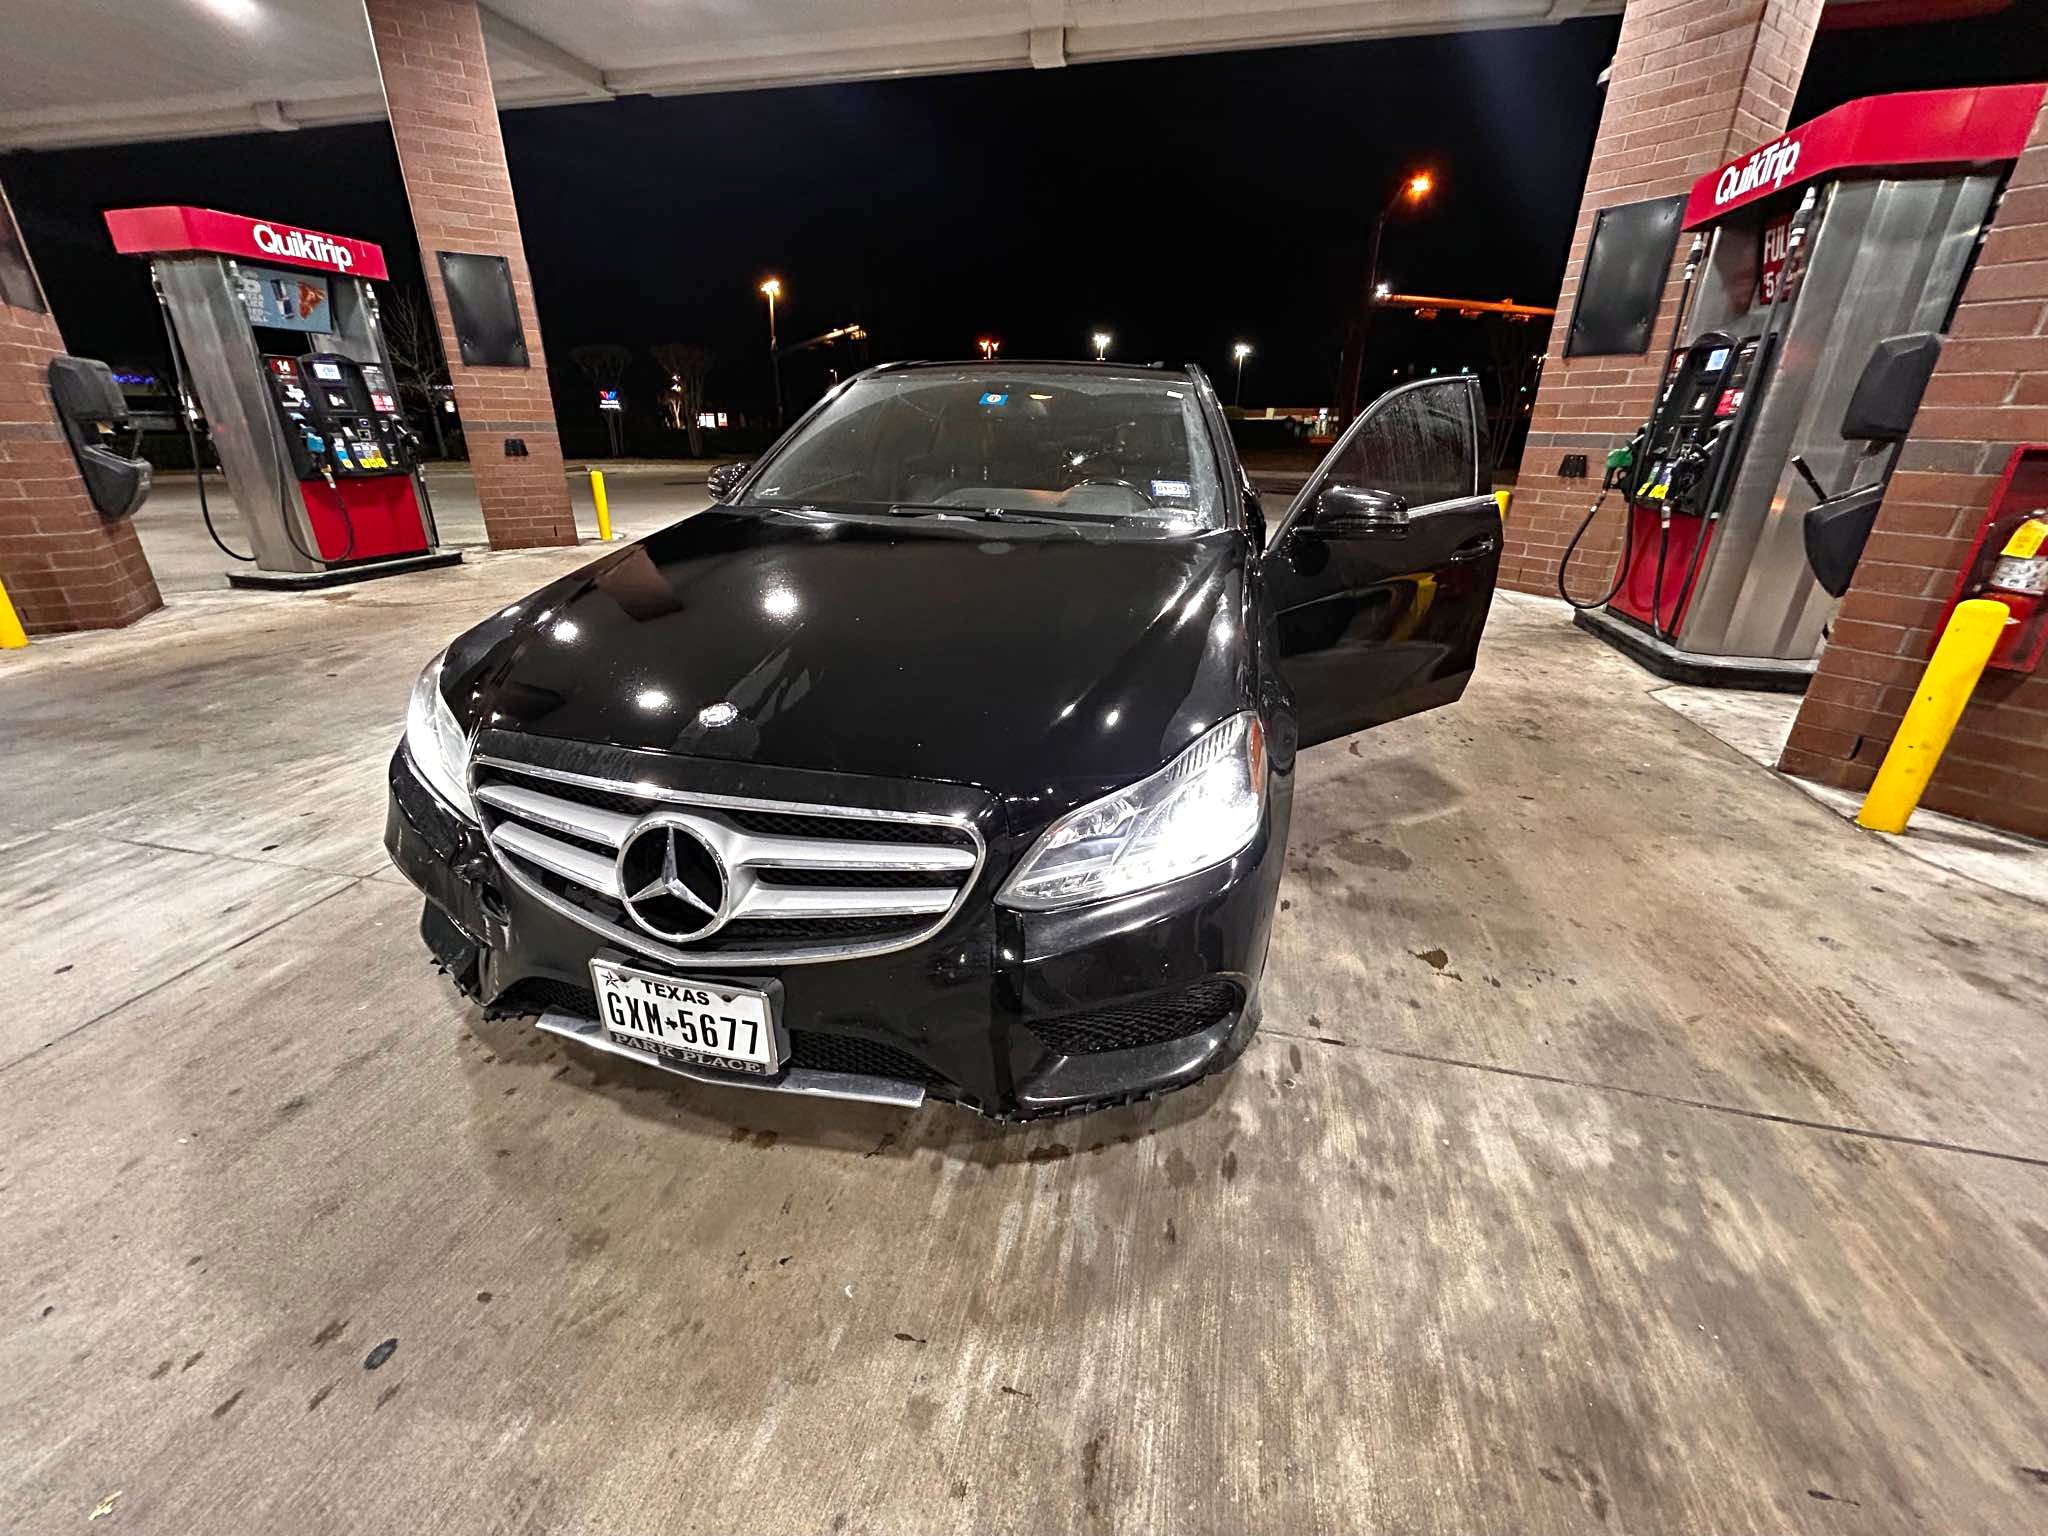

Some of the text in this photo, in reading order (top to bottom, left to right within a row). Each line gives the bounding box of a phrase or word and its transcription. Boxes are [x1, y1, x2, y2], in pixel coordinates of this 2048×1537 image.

[1715, 137, 1800, 205] QuikTrip
[253, 224, 353, 272] QuikTrip
[277, 360, 291, 371] 14
[641, 979, 710, 1006] TEXAS
[614, 1034, 761, 1073] PARK PLACE
